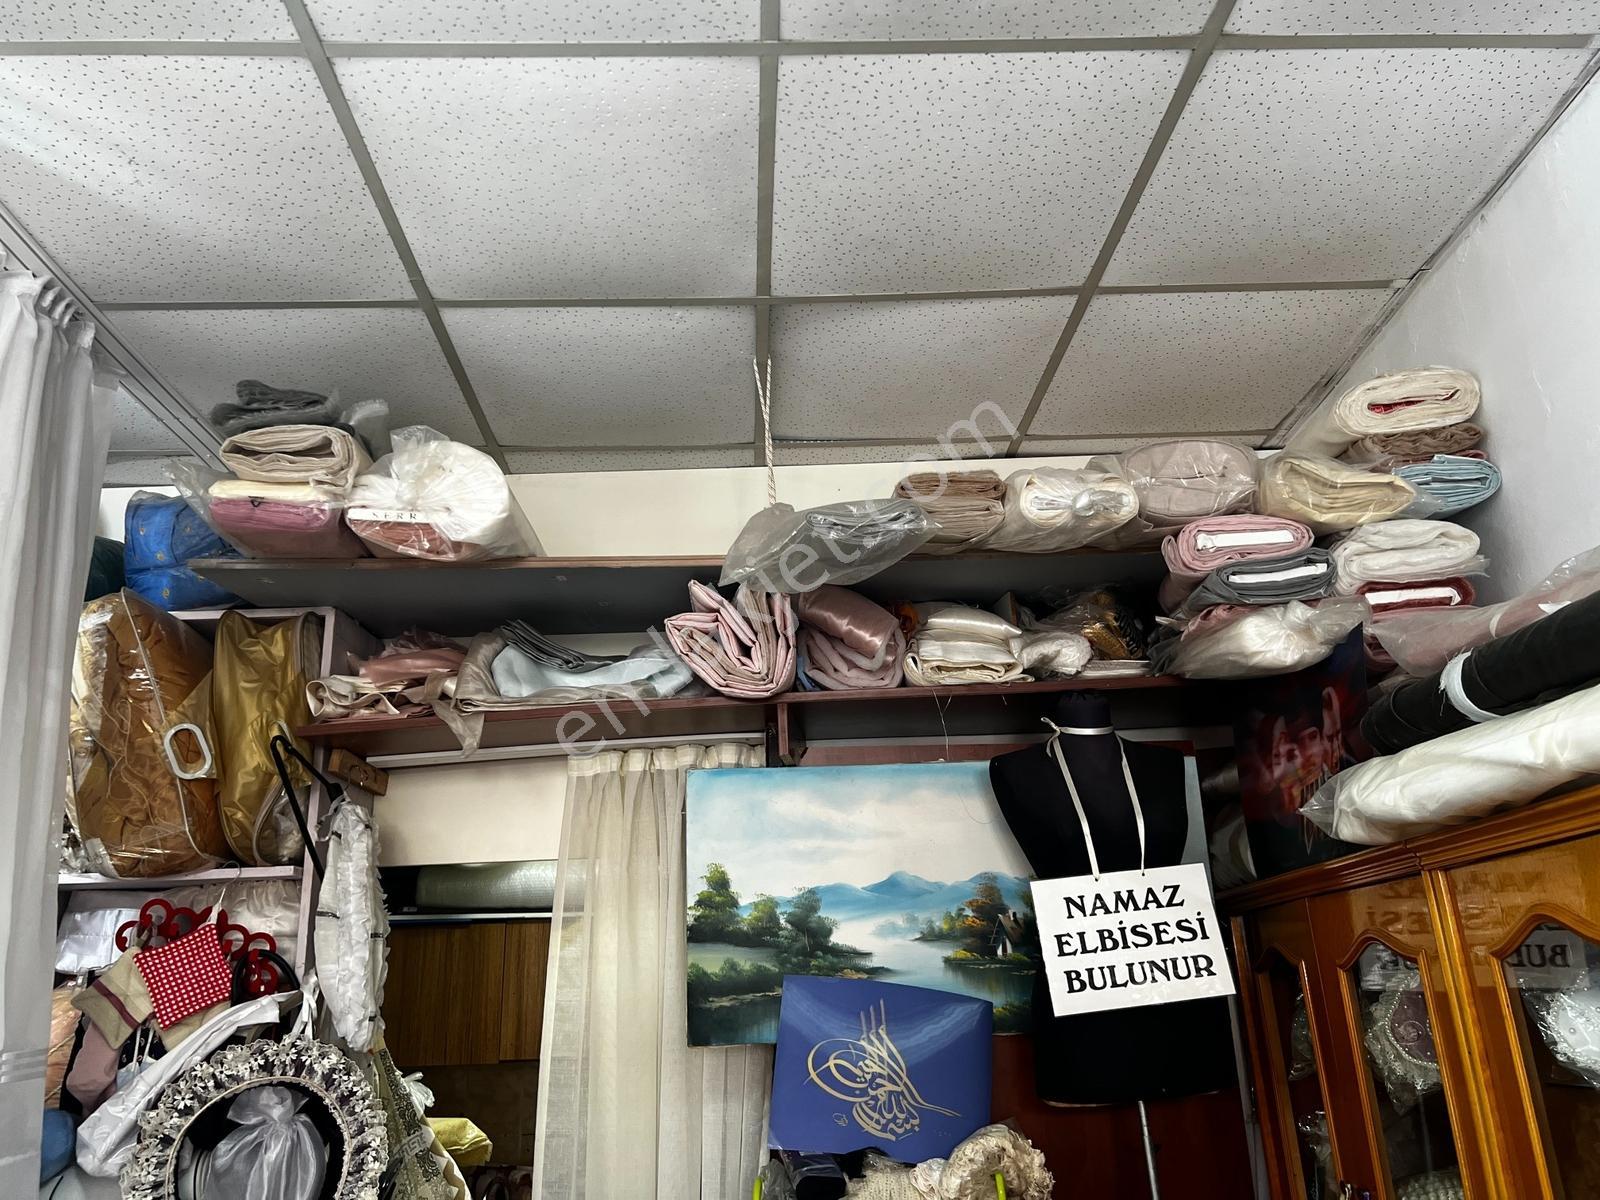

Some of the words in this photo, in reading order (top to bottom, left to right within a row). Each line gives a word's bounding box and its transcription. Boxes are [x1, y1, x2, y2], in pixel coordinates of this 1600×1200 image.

[1063, 884, 1185, 919] NAMAZ
[1054, 911, 1210, 958] ELBİSESİ
[1064, 954, 1217, 994] BULUNUR
